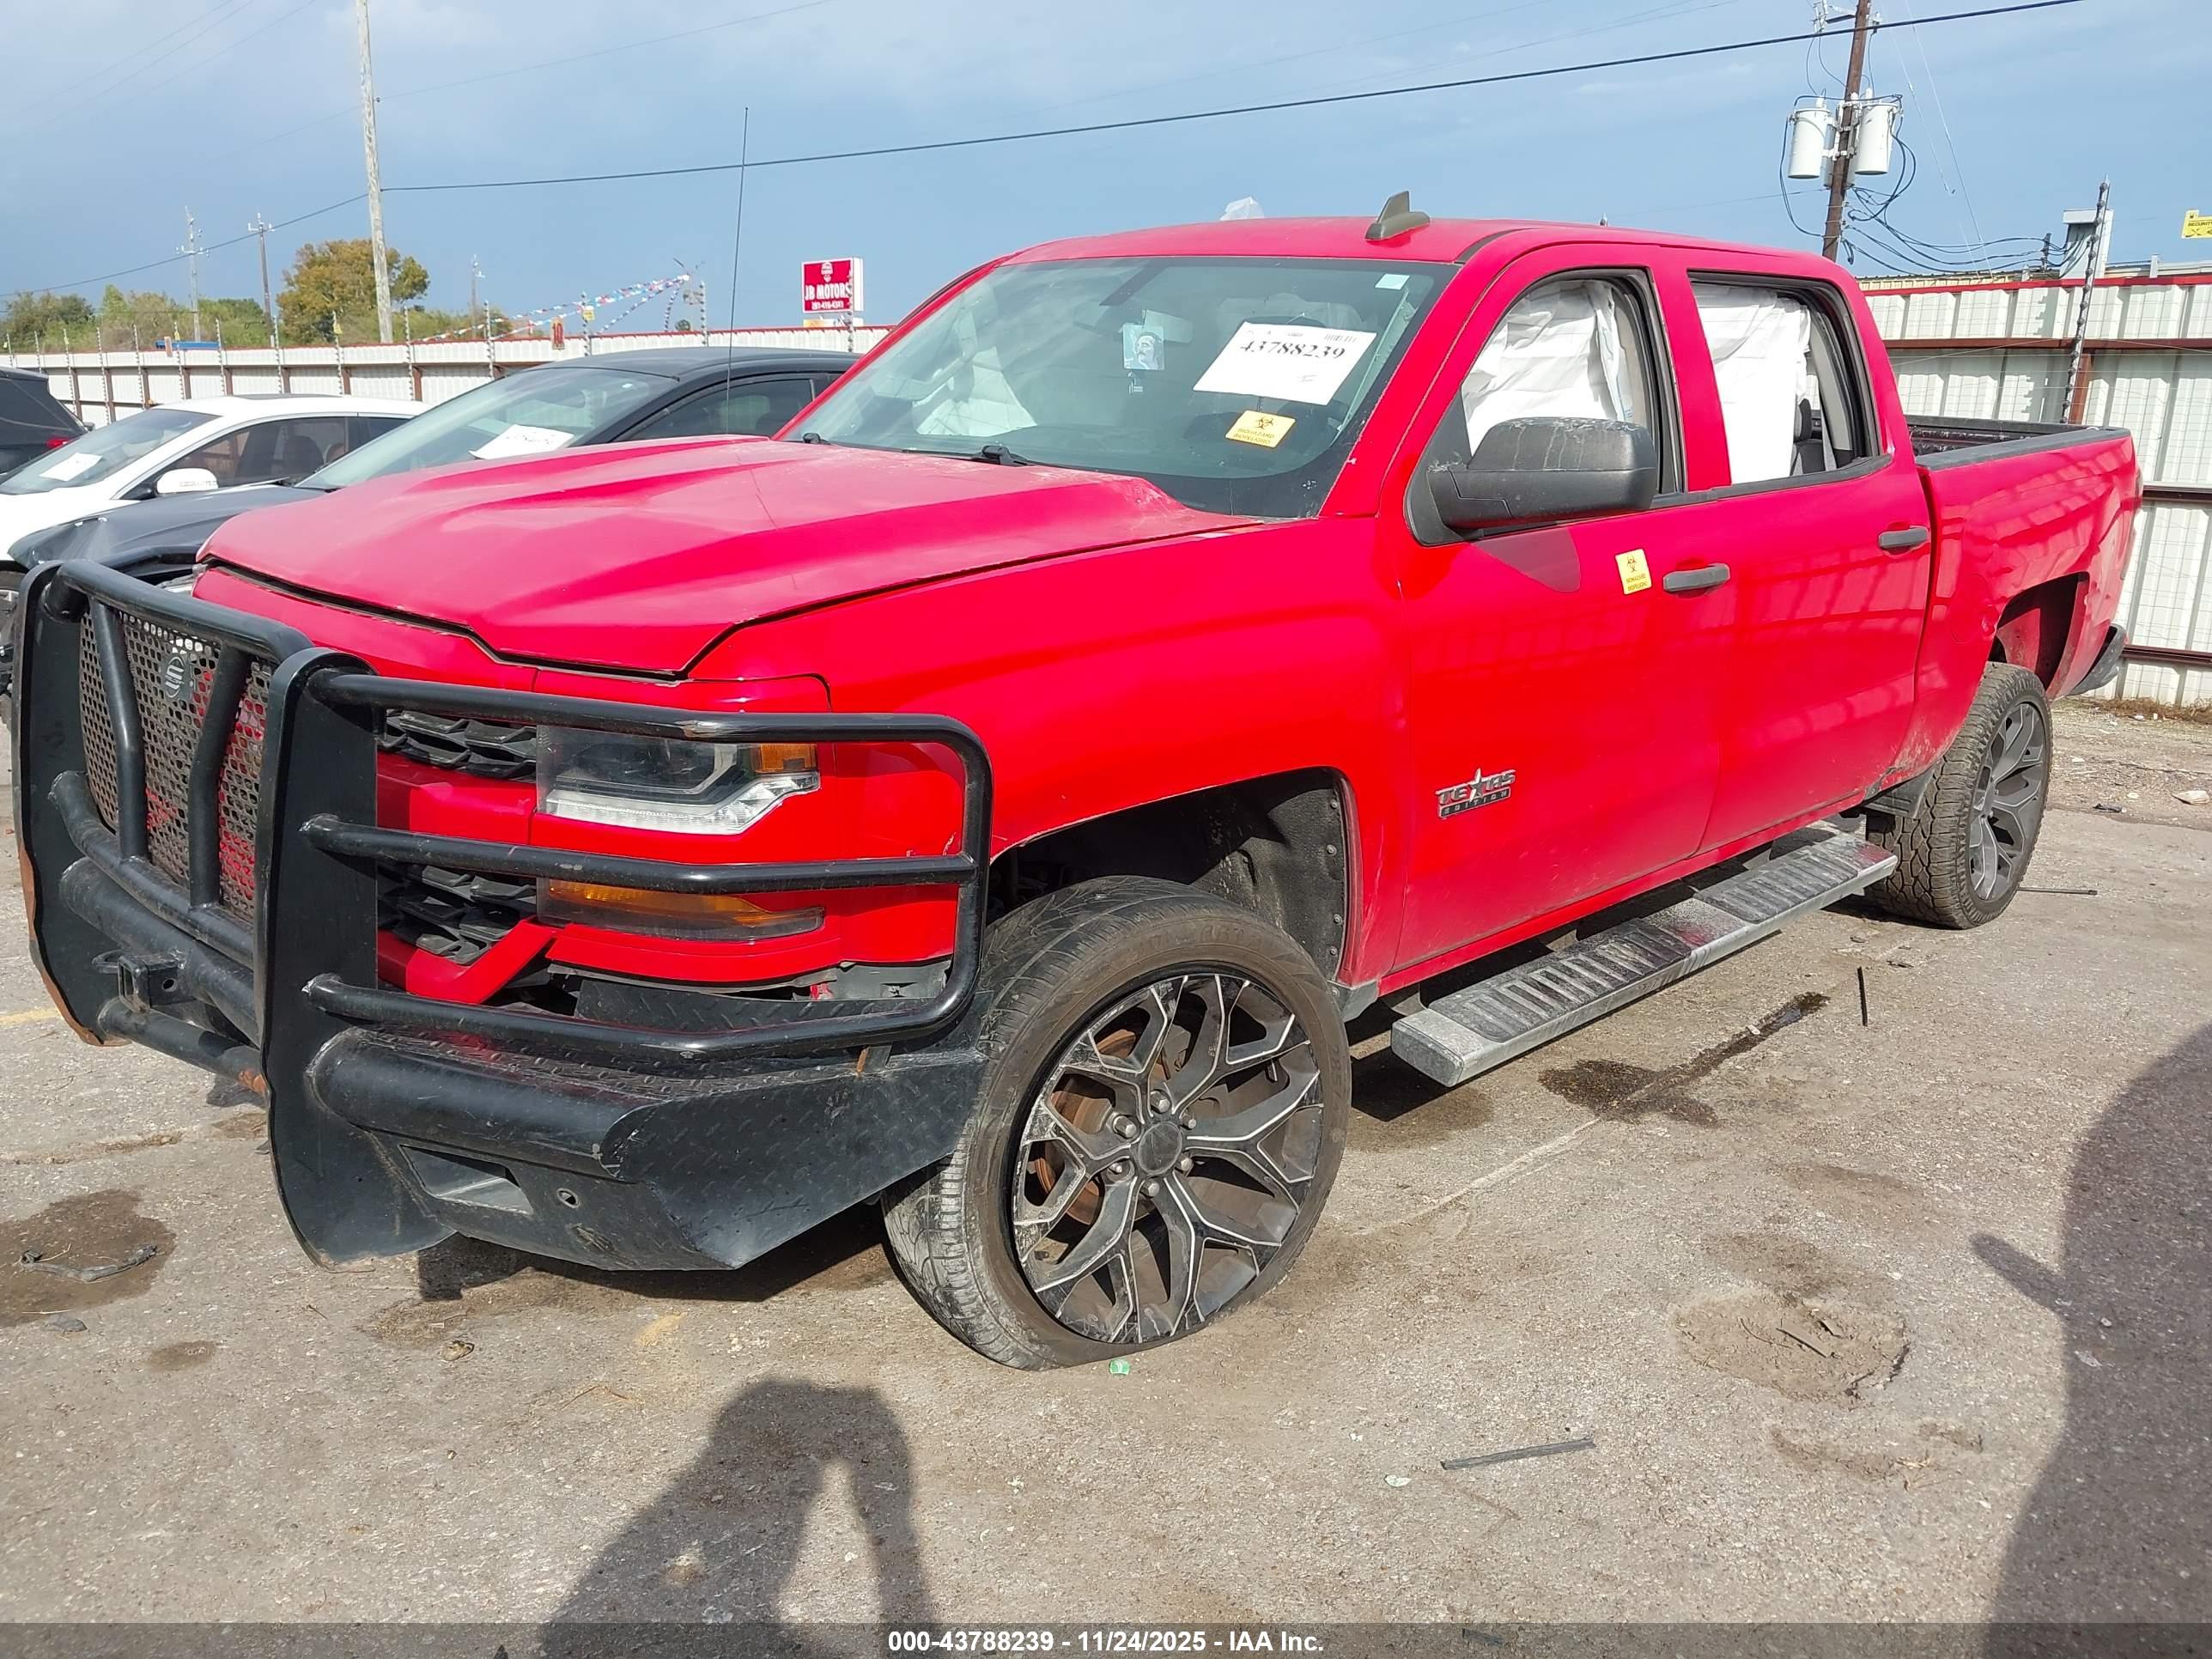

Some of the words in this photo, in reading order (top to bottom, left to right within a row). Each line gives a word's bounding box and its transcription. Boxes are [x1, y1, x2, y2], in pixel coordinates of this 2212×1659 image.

[805, 284, 816, 301] JB
[817, 283, 851, 299] MOTORS
[1240, 340, 1346, 359] 43788239
[1237, 428, 1275, 439] BIOHAZARD
[1435, 768, 1516, 805] TEXAS
[1443, 789, 1508, 815] EDITION
